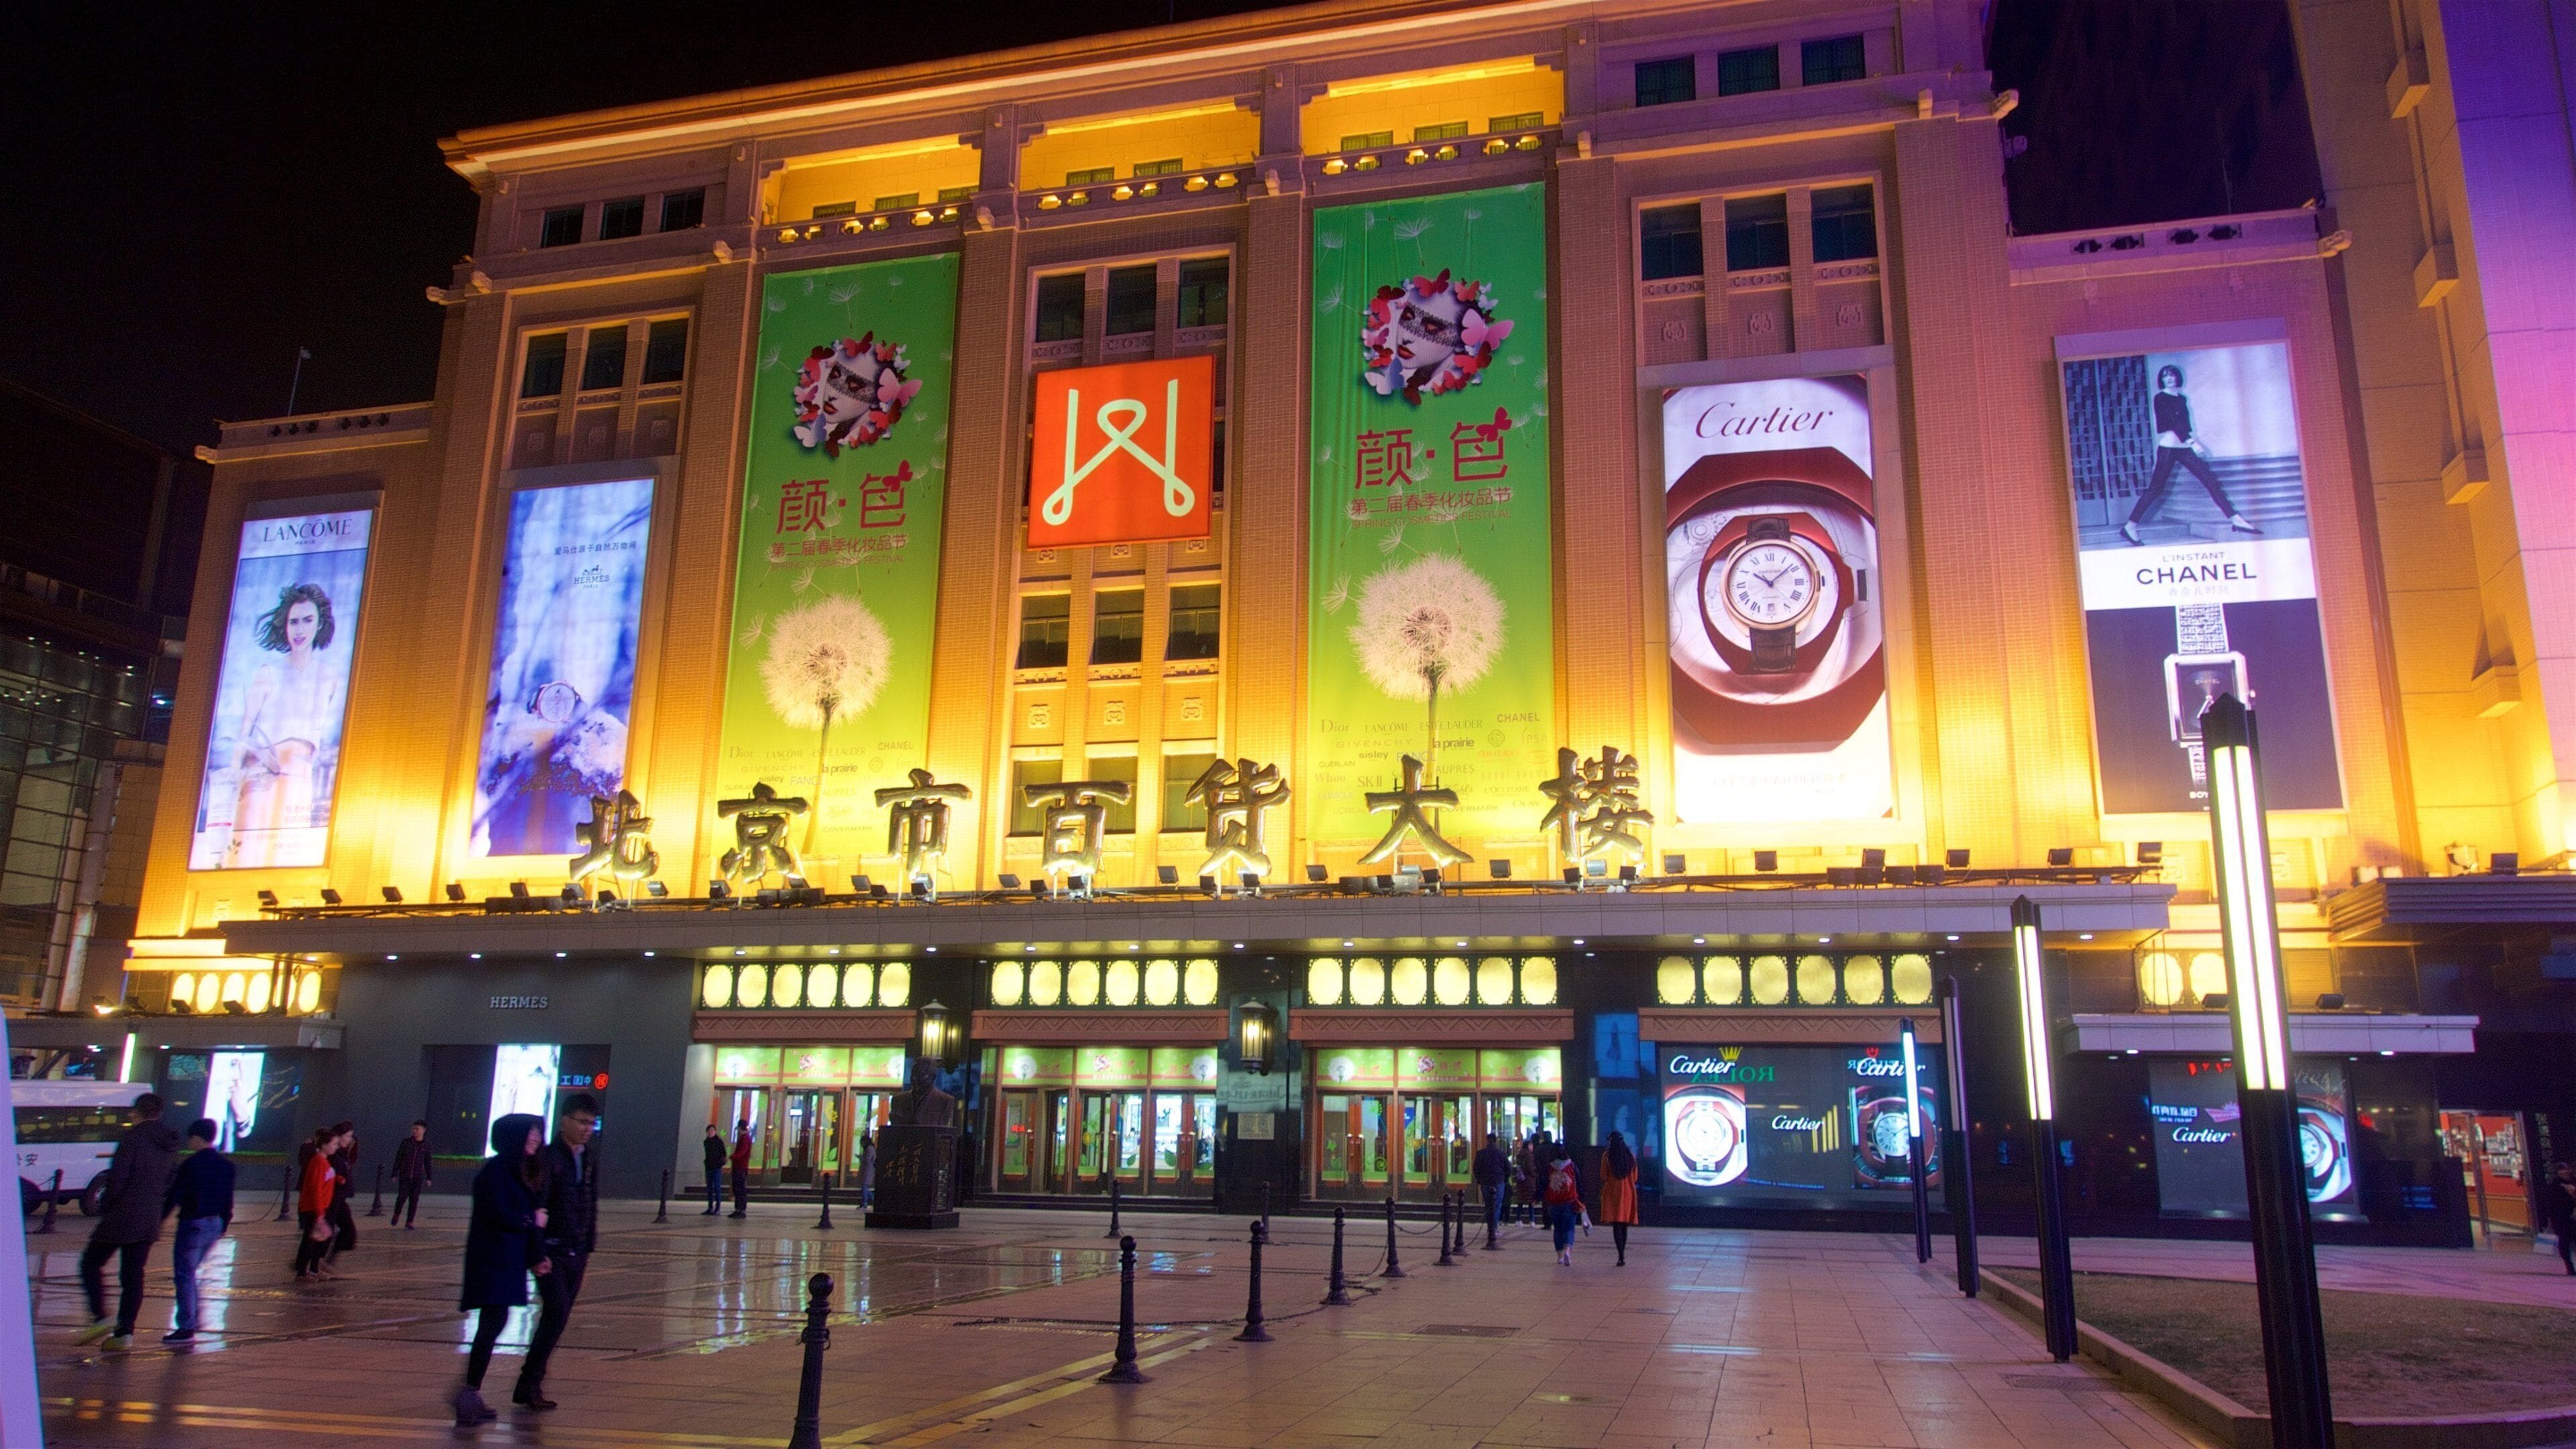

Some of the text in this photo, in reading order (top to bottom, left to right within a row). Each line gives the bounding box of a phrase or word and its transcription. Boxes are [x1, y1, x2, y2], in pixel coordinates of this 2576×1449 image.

[1696, 401, 1833, 438] Cartier
[1351, 486, 1511, 516] 第二届春季化妆品节
[1352, 519, 1391, 530] SPRING
[1461, 510, 1511, 523] FESTIVAL
[263, 519, 353, 543] LANCÔME
[771, 534, 907, 559] 第二届春季化妆品节
[864, 553, 904, 565] FESTIVAL
[2163, 551, 2225, 562] L'INSTANT
[2137, 563, 2257, 585] CHANEL
[1497, 712, 1540, 723] CHANEL
[1321, 719, 1351, 733] Dior
[878, 741, 914, 751] CHANEL
[1336, 739, 1414, 749] GIVENCHY
[1443, 737, 1475, 751] prairie
[730, 746, 755, 759] Dior
[1358, 750, 1389, 760] sisley
[830, 762, 859, 776] prairie
[569, 745, 1654, 883] 北京市百货大楼
[1670, 1055, 1736, 1075] Cartier
[1856, 1057, 1927, 1077] Cartir
[1772, 1114, 1825, 1131] Cartier
[2173, 1126, 2231, 1142] Cartier
